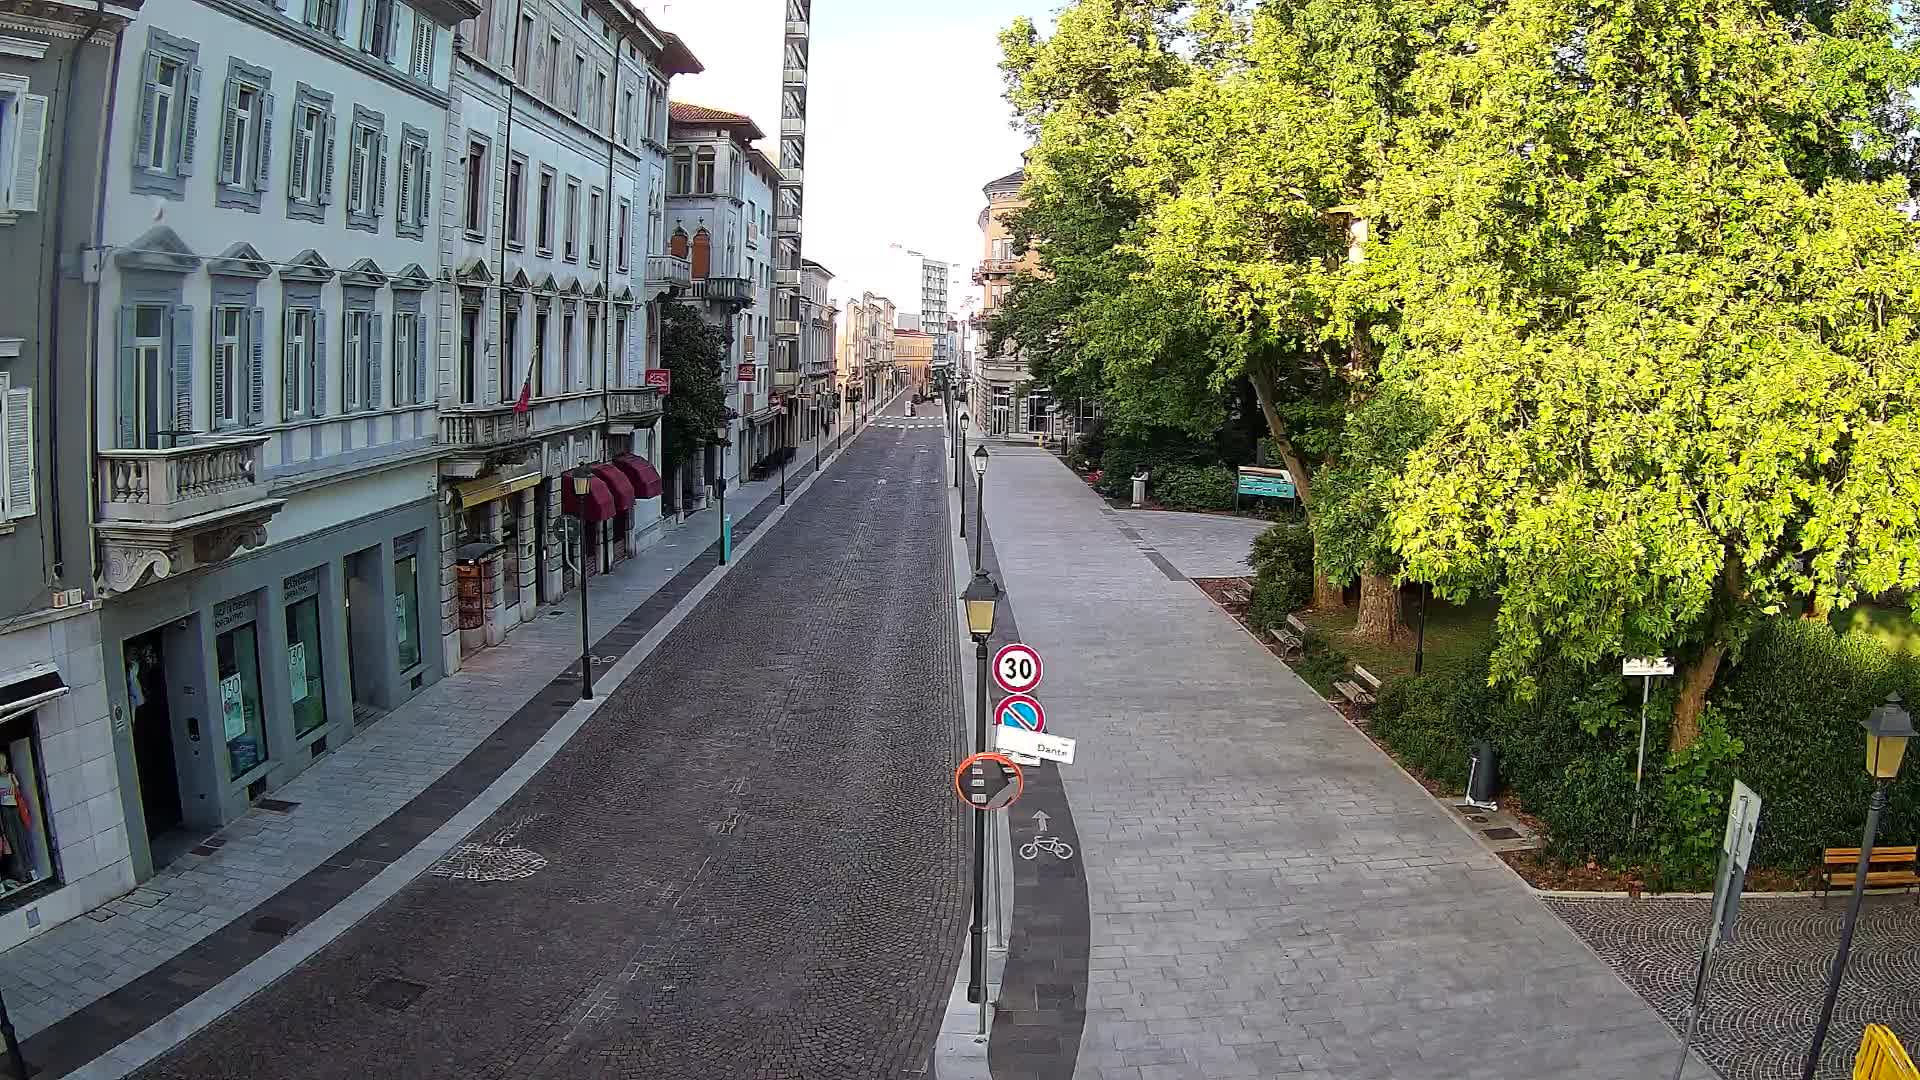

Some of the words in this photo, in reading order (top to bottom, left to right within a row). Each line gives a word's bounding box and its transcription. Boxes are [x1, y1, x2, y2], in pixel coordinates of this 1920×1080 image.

[1005, 657, 1032, 680] 30
[222, 677, 240, 700] 130
[1037, 743, 1069, 757] Dante
